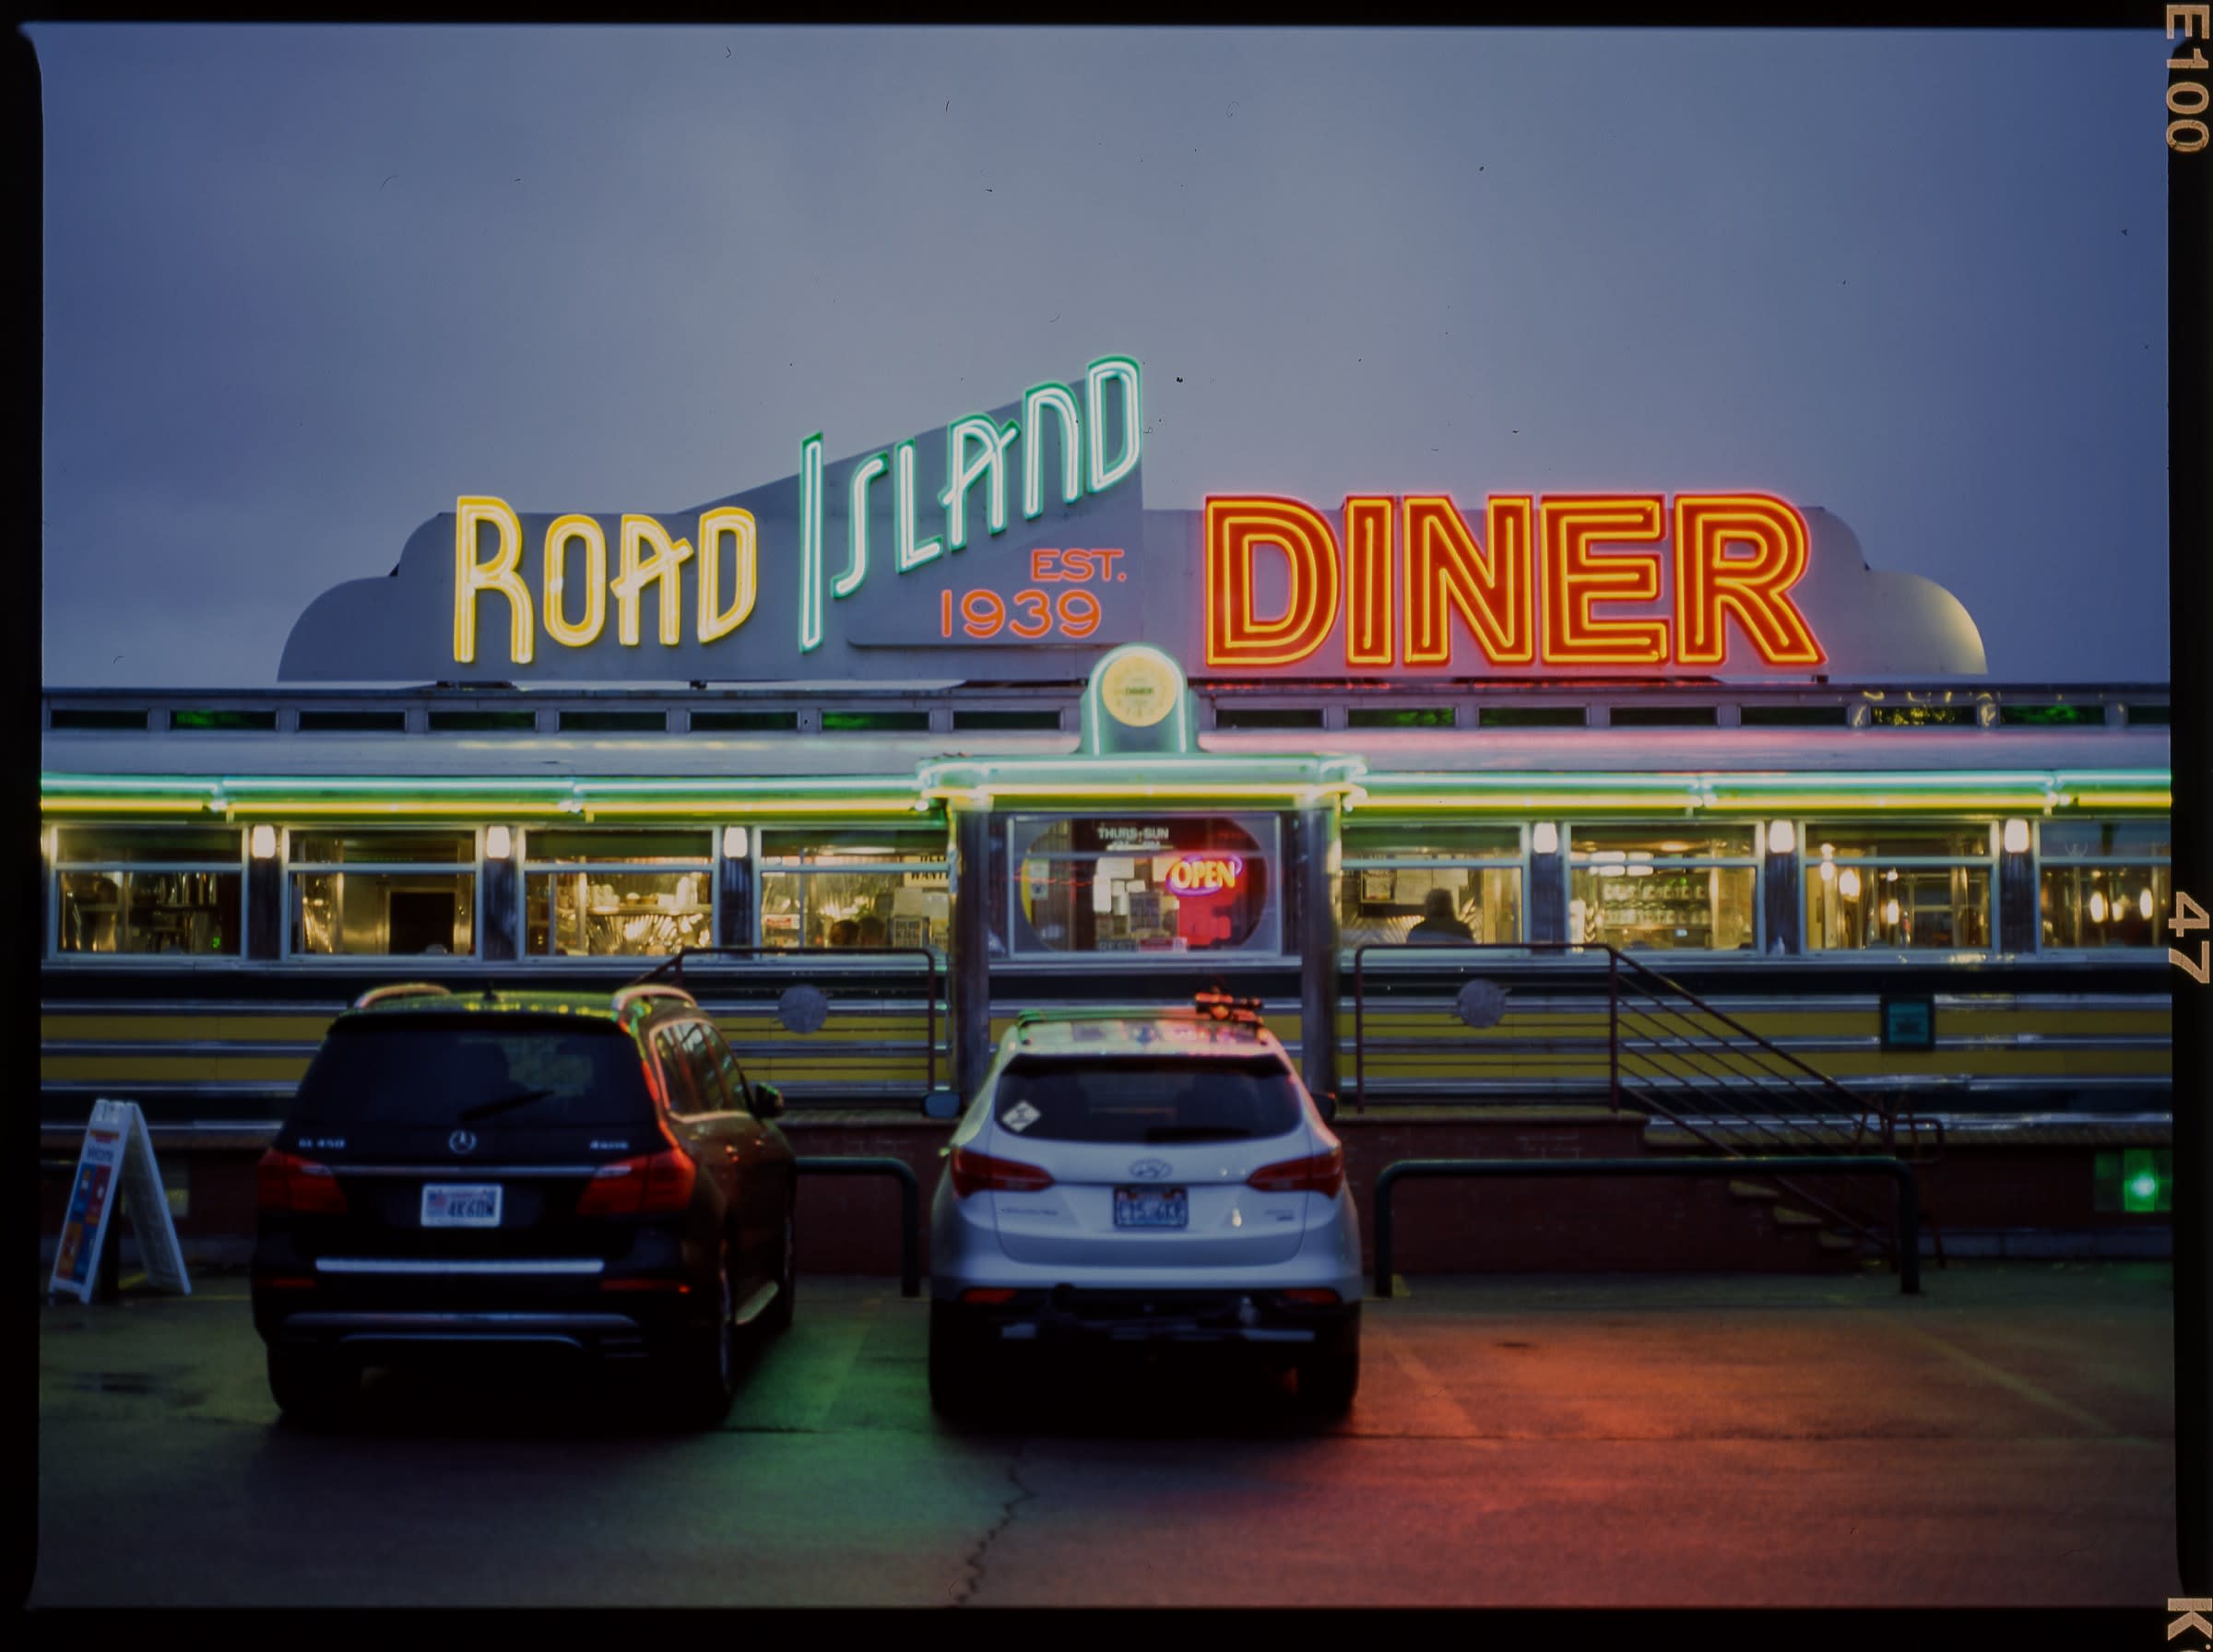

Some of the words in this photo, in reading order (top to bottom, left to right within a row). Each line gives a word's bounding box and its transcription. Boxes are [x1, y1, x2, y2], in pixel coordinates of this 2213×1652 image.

[2166, 4, 2210, 152] E100
[454, 495, 758, 664] ROAD
[799, 354, 1142, 653] ISLAND
[1205, 492, 1828, 667] DINER
[1031, 548, 1127, 583] EST.
[941, 588, 1102, 639] 1939
[1170, 860, 1236, 889] OPEN
[2168, 891, 2210, 984] 47
